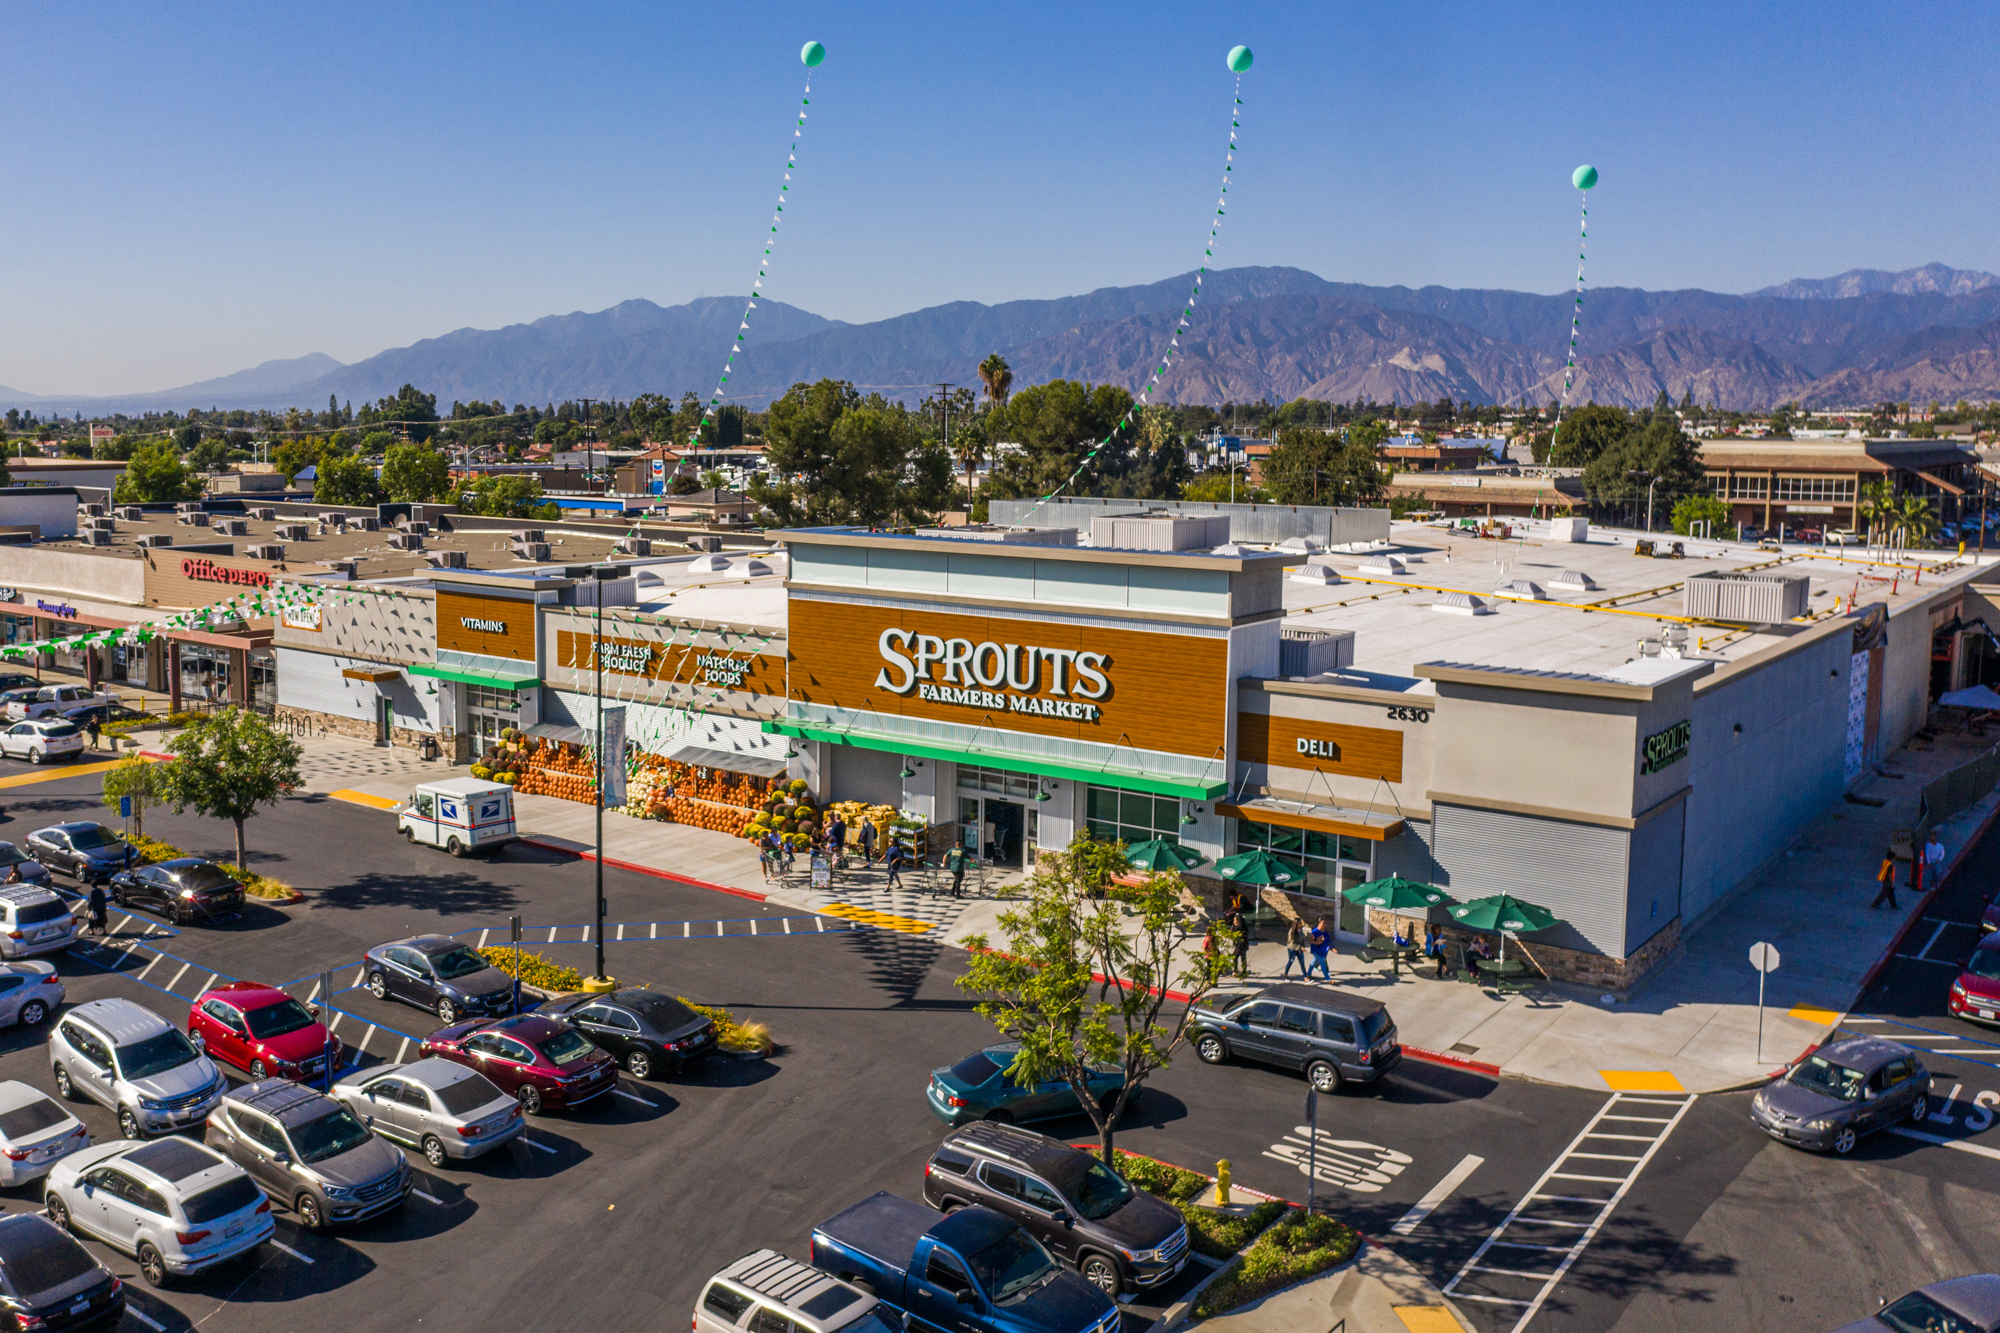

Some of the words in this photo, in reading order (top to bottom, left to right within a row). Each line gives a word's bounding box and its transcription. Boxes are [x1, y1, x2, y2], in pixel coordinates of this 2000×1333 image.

[181, 558, 227, 582] Office
[228, 568, 275, 587] DEPOT
[37, 599, 60, 615] Massage
[61, 603, 75, 617] Envy
[460, 616, 504, 632] VITAMINS
[696, 654, 750, 673] NATURAL
[874, 627, 1109, 699] SPROUTS
[705, 669, 742, 686] FOODS
[918, 683, 1005, 709] FARMERS
[1009, 694, 1097, 721] MARKET
[1387, 705, 1430, 724] 2630
[1296, 737, 1334, 757] DELI
[1646, 719, 1691, 775] SPROUTS
[1928, 1078, 2000, 1131] ST
